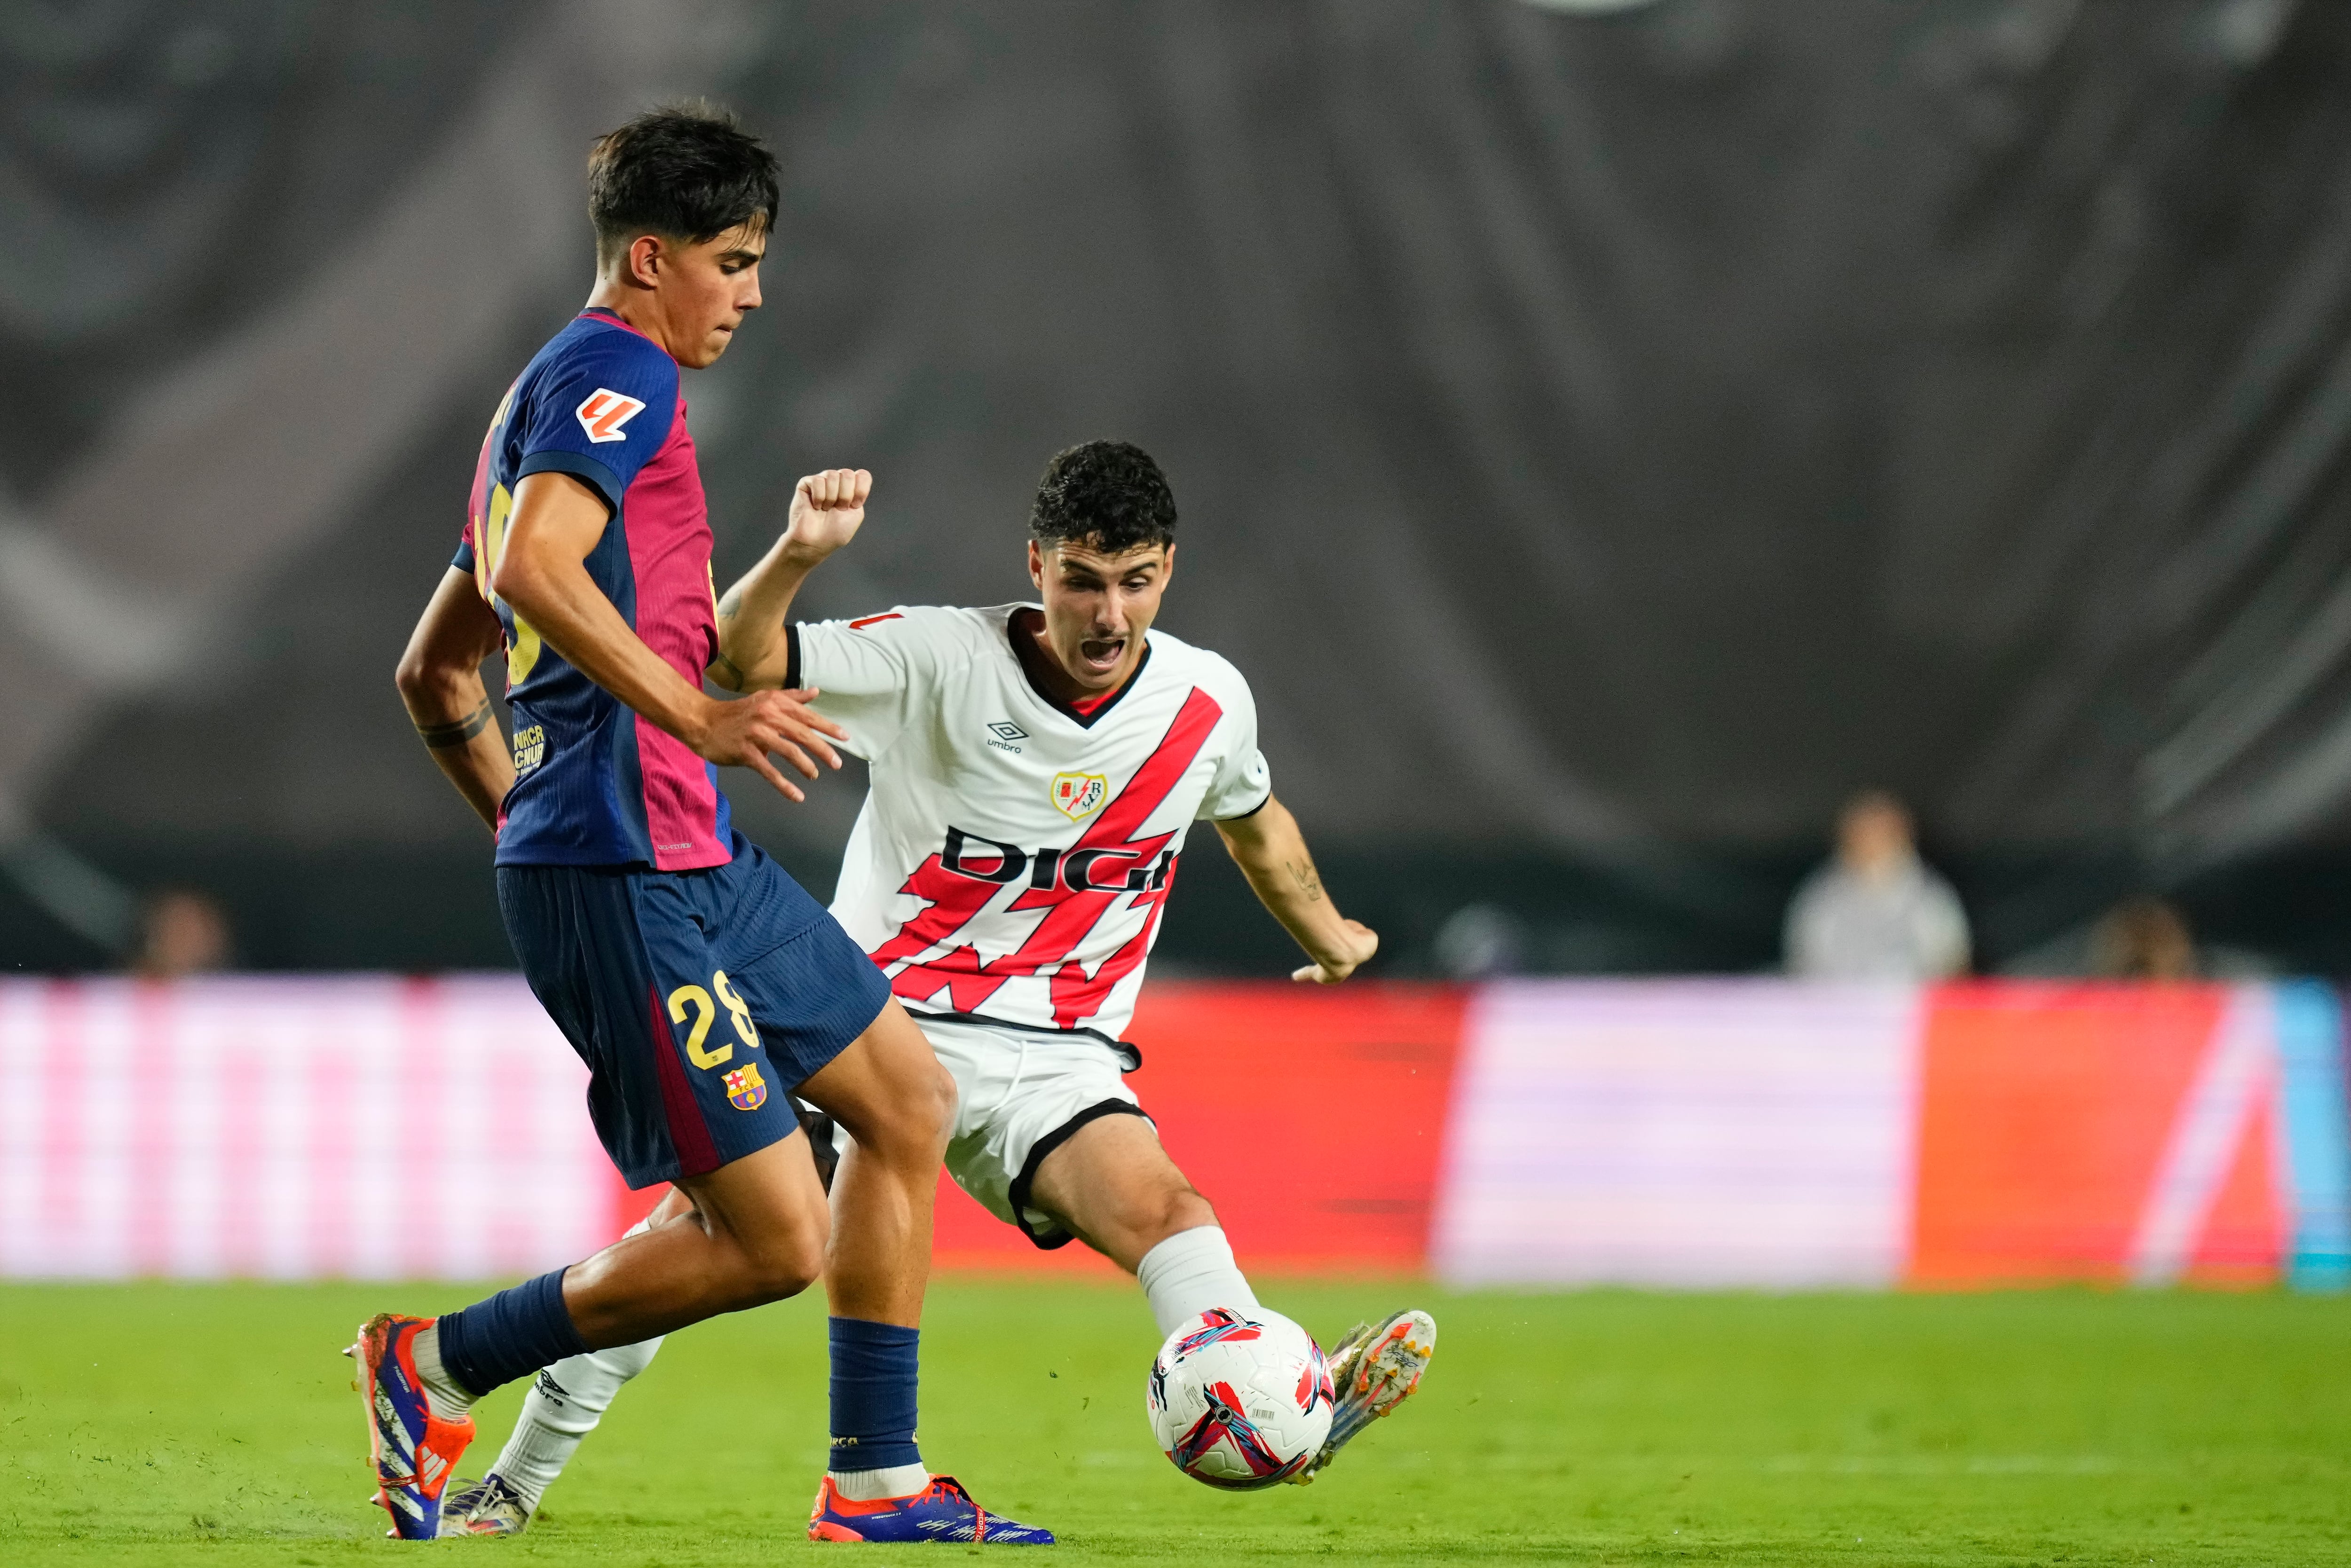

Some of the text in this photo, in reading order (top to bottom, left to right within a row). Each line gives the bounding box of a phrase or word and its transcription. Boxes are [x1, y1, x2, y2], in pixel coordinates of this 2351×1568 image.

[513, 725, 544, 750] NHCR
[987, 739, 1021, 753] umbro
[940, 825, 1175, 893] DIGI
[667, 969, 759, 1070] 28
[535, 1381, 563, 1407] mbro
